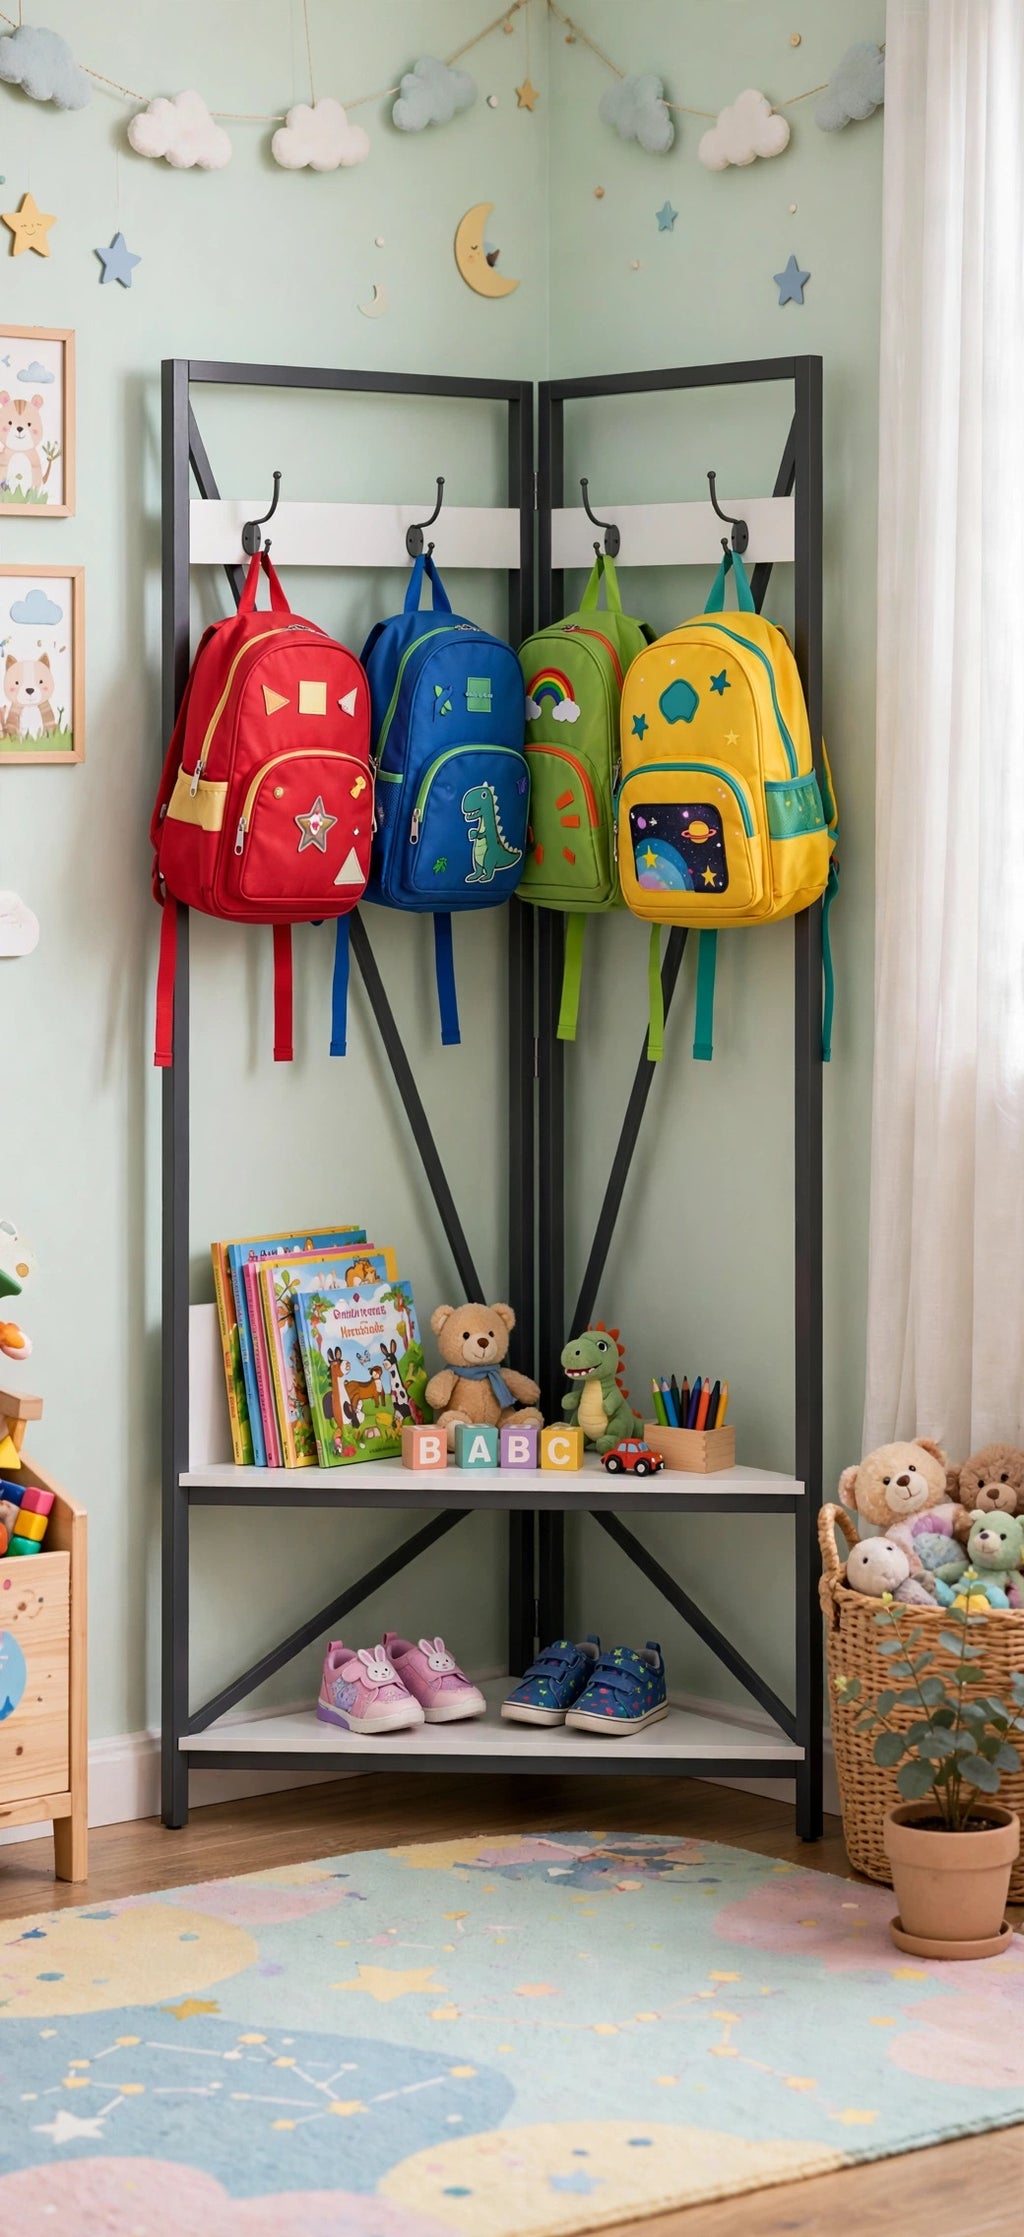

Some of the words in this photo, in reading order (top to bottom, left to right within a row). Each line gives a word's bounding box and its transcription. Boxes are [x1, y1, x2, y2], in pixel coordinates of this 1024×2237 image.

[419, 1436, 441, 1464] B
[468, 1435, 492, 1463] A
[508, 1435, 530, 1463] B
[547, 1437, 570, 1465] C
